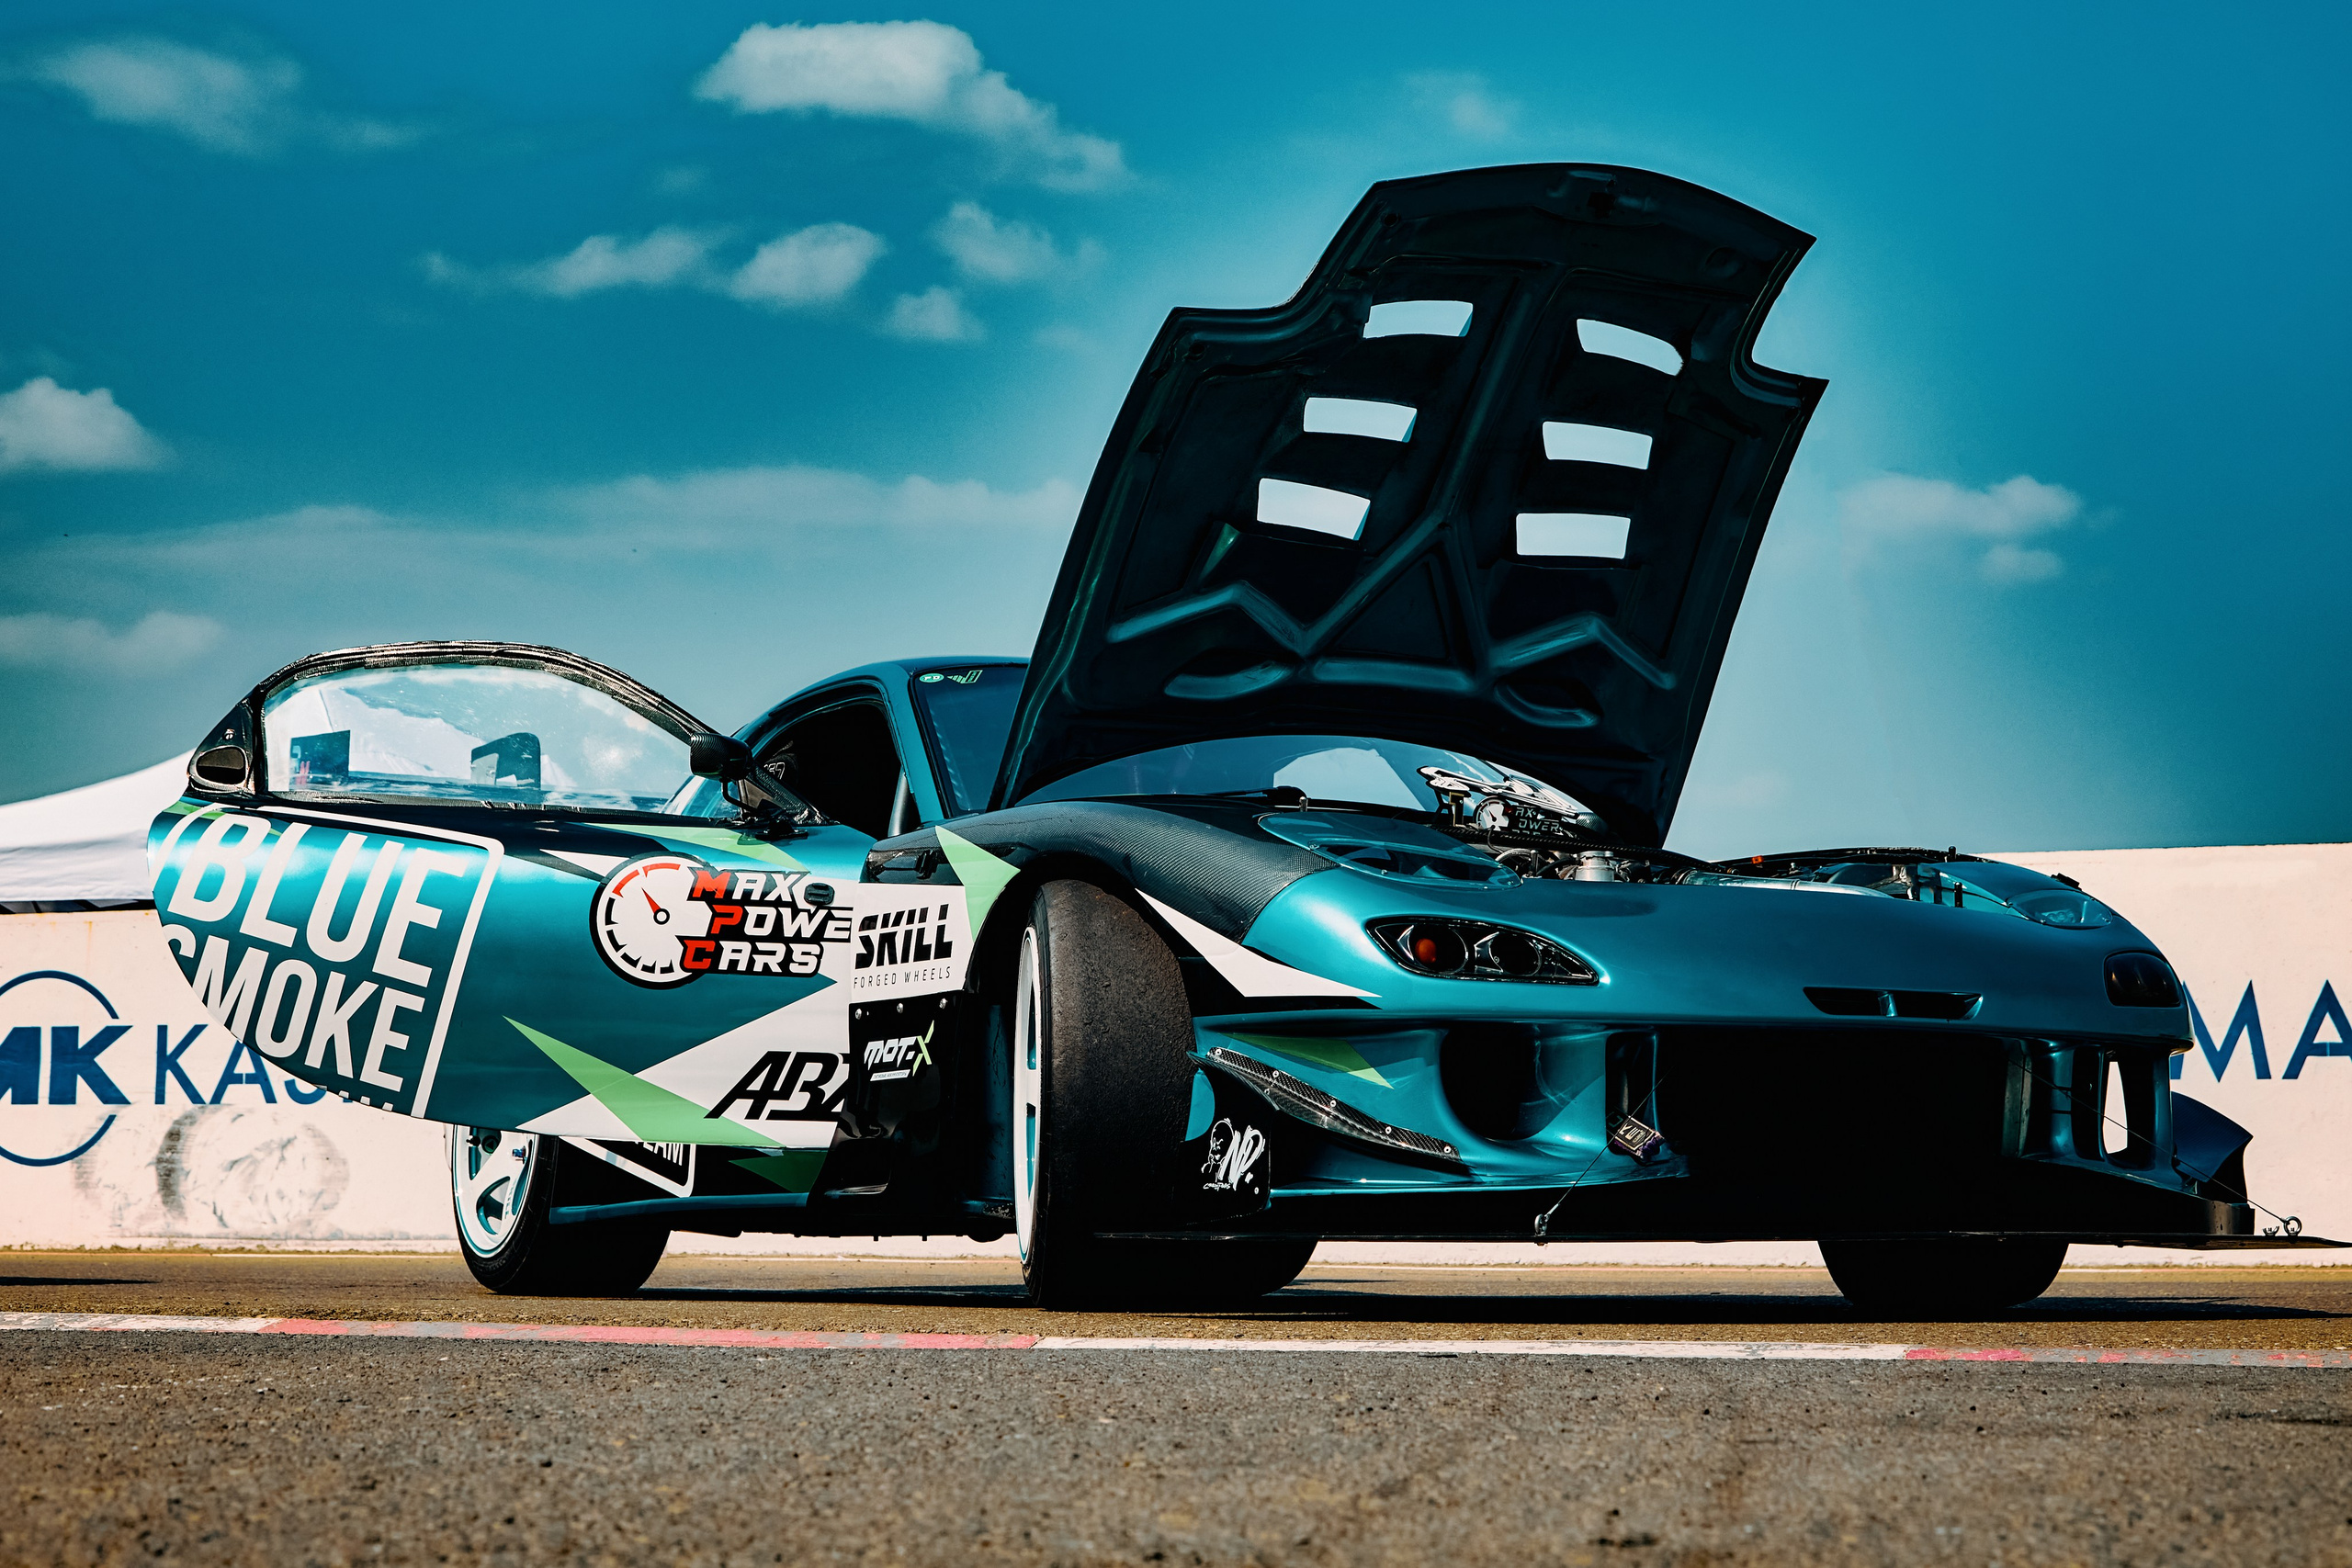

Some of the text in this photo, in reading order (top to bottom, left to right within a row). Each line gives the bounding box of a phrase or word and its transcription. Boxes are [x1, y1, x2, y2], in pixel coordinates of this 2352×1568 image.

[167, 813, 469, 987] BLUE
[692, 871, 802, 902] MAX
[711, 905, 853, 939] POWE
[855, 904, 953, 969] SKILL
[683, 940, 820, 974] CARS
[854, 965, 951, 989] FORGED WHEELS
[2170, 979, 2352, 1083] MA
